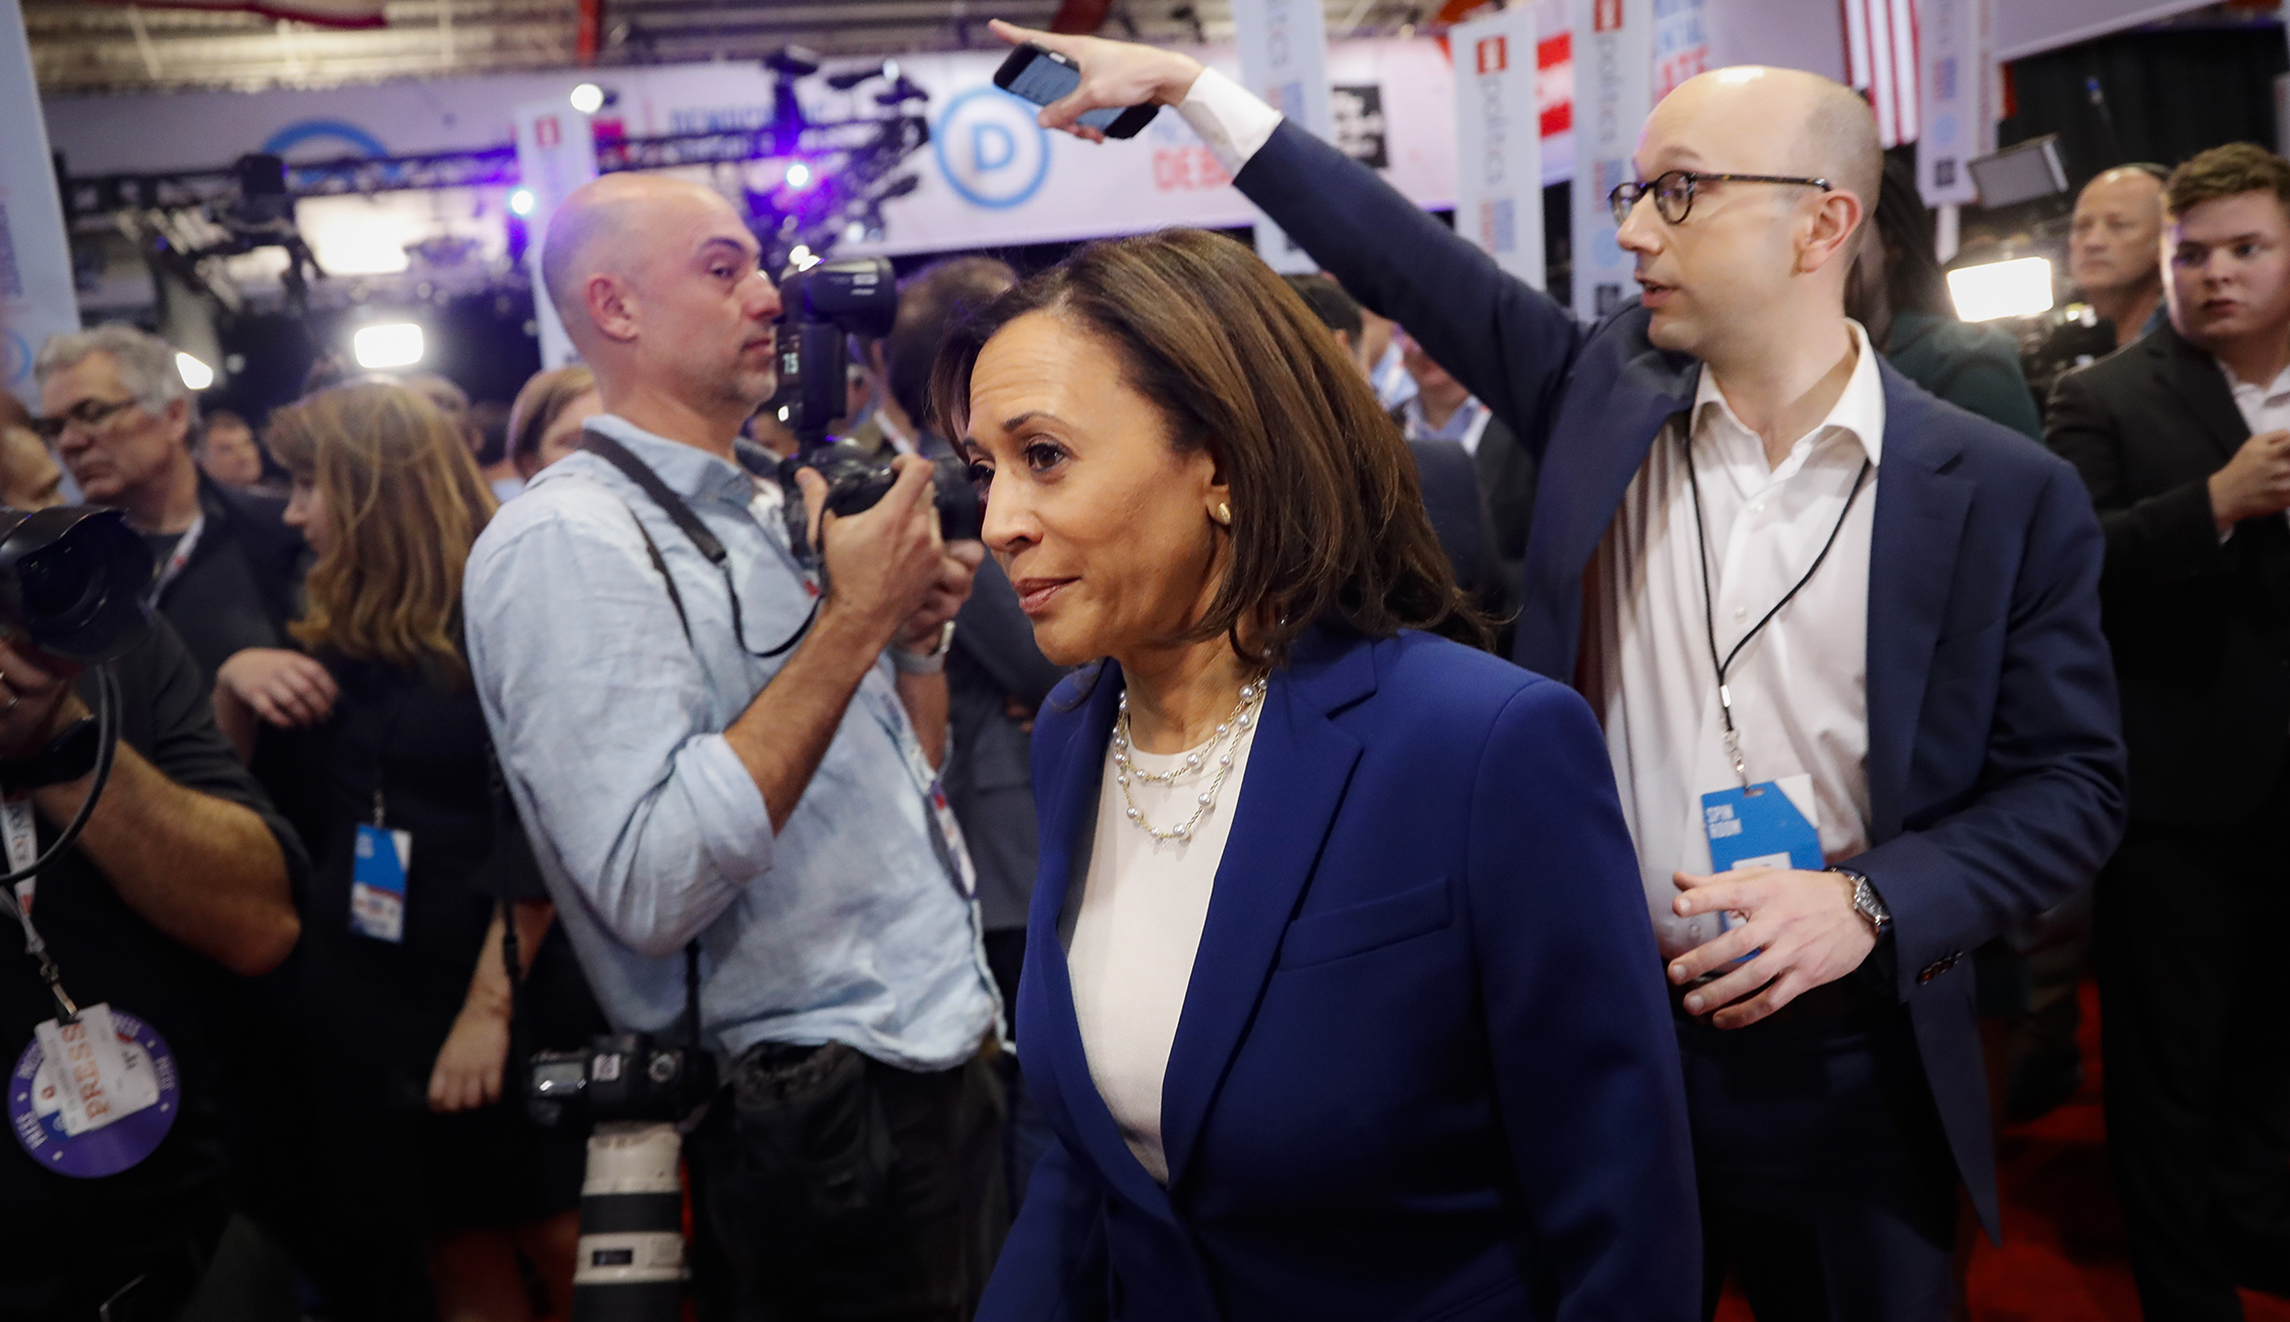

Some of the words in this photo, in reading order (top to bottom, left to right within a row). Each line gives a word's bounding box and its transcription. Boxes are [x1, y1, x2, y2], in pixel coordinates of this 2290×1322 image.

[1596, 33, 1622, 145] politics
[971, 123, 1016, 171] D
[1480, 76, 1509, 186] politics
[1706, 804, 1734, 823] SPIN
[1709, 818, 1742, 839] ROOM
[61, 1022, 111, 1120] PRESS
